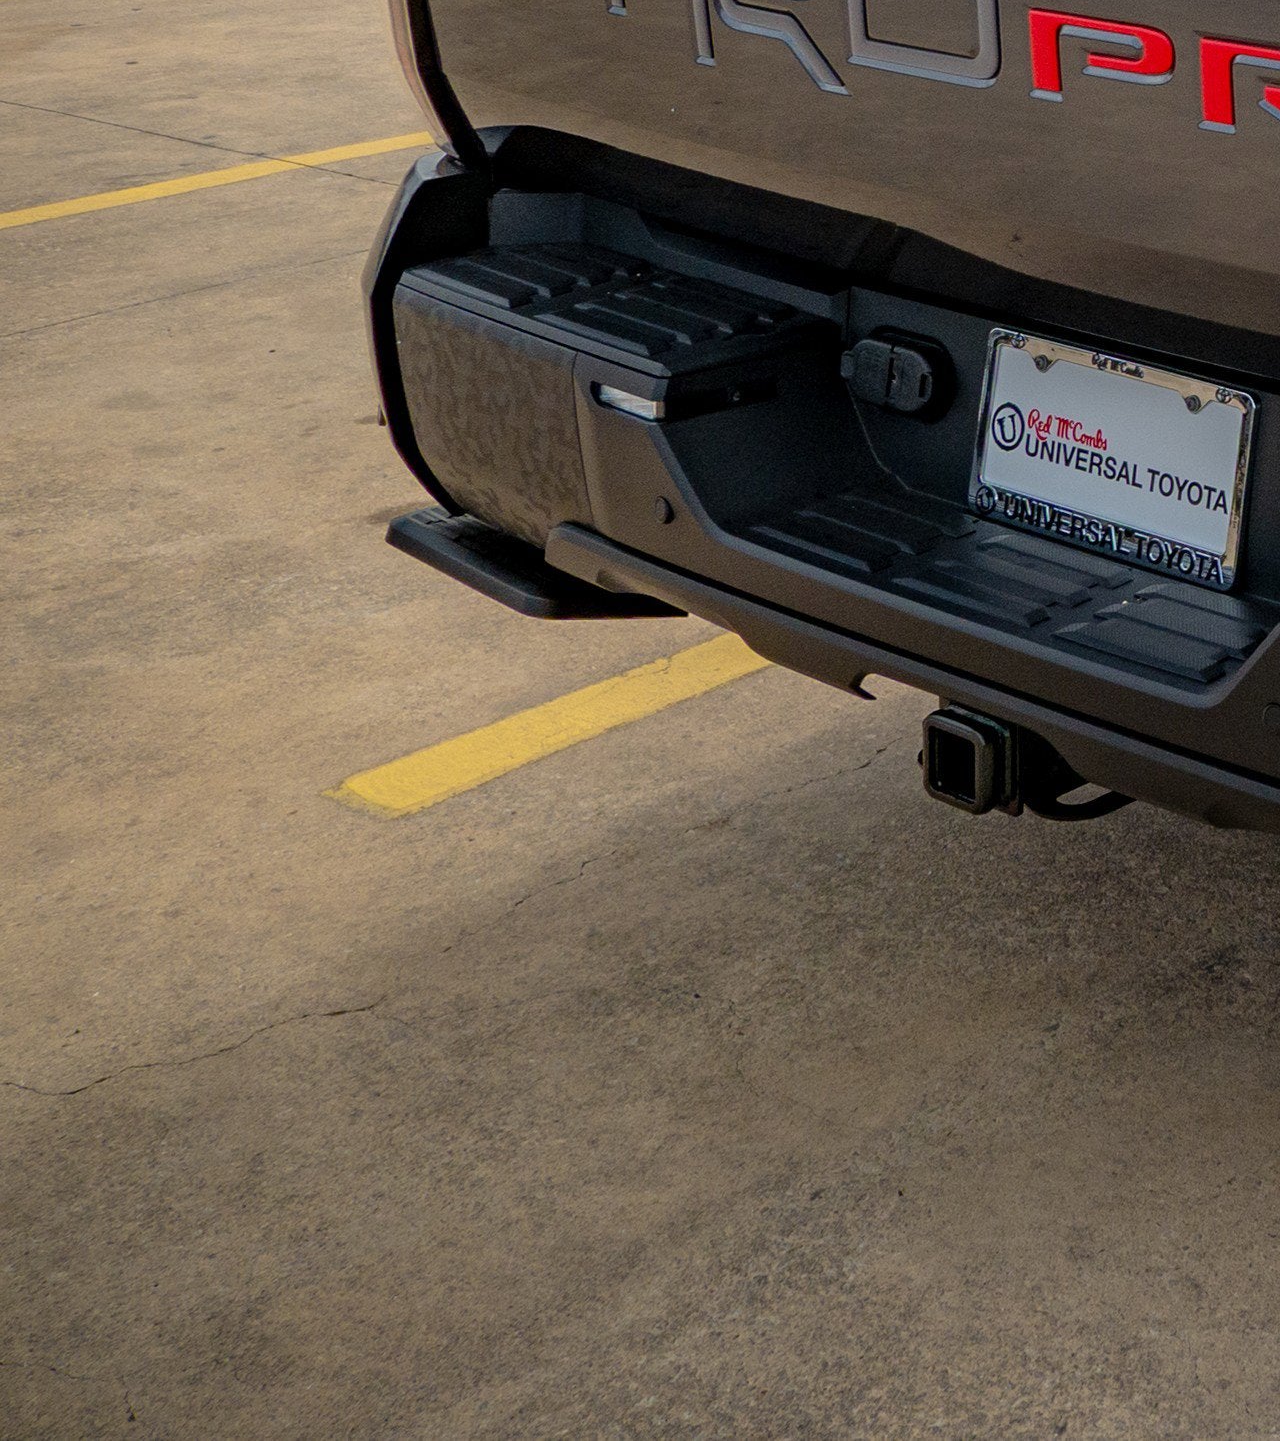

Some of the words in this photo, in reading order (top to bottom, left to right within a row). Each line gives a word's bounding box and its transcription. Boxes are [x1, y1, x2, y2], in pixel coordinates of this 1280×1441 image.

[1027, 408, 1053, 441] Red
[1054, 415, 1107, 451] McCombs
[1025, 433, 1143, 489] UNIVERSAL
[1147, 468, 1229, 514] TOYOTA
[1003, 493, 1131, 554] UNIVERSAL
[1134, 531, 1225, 585] TOYOTA
